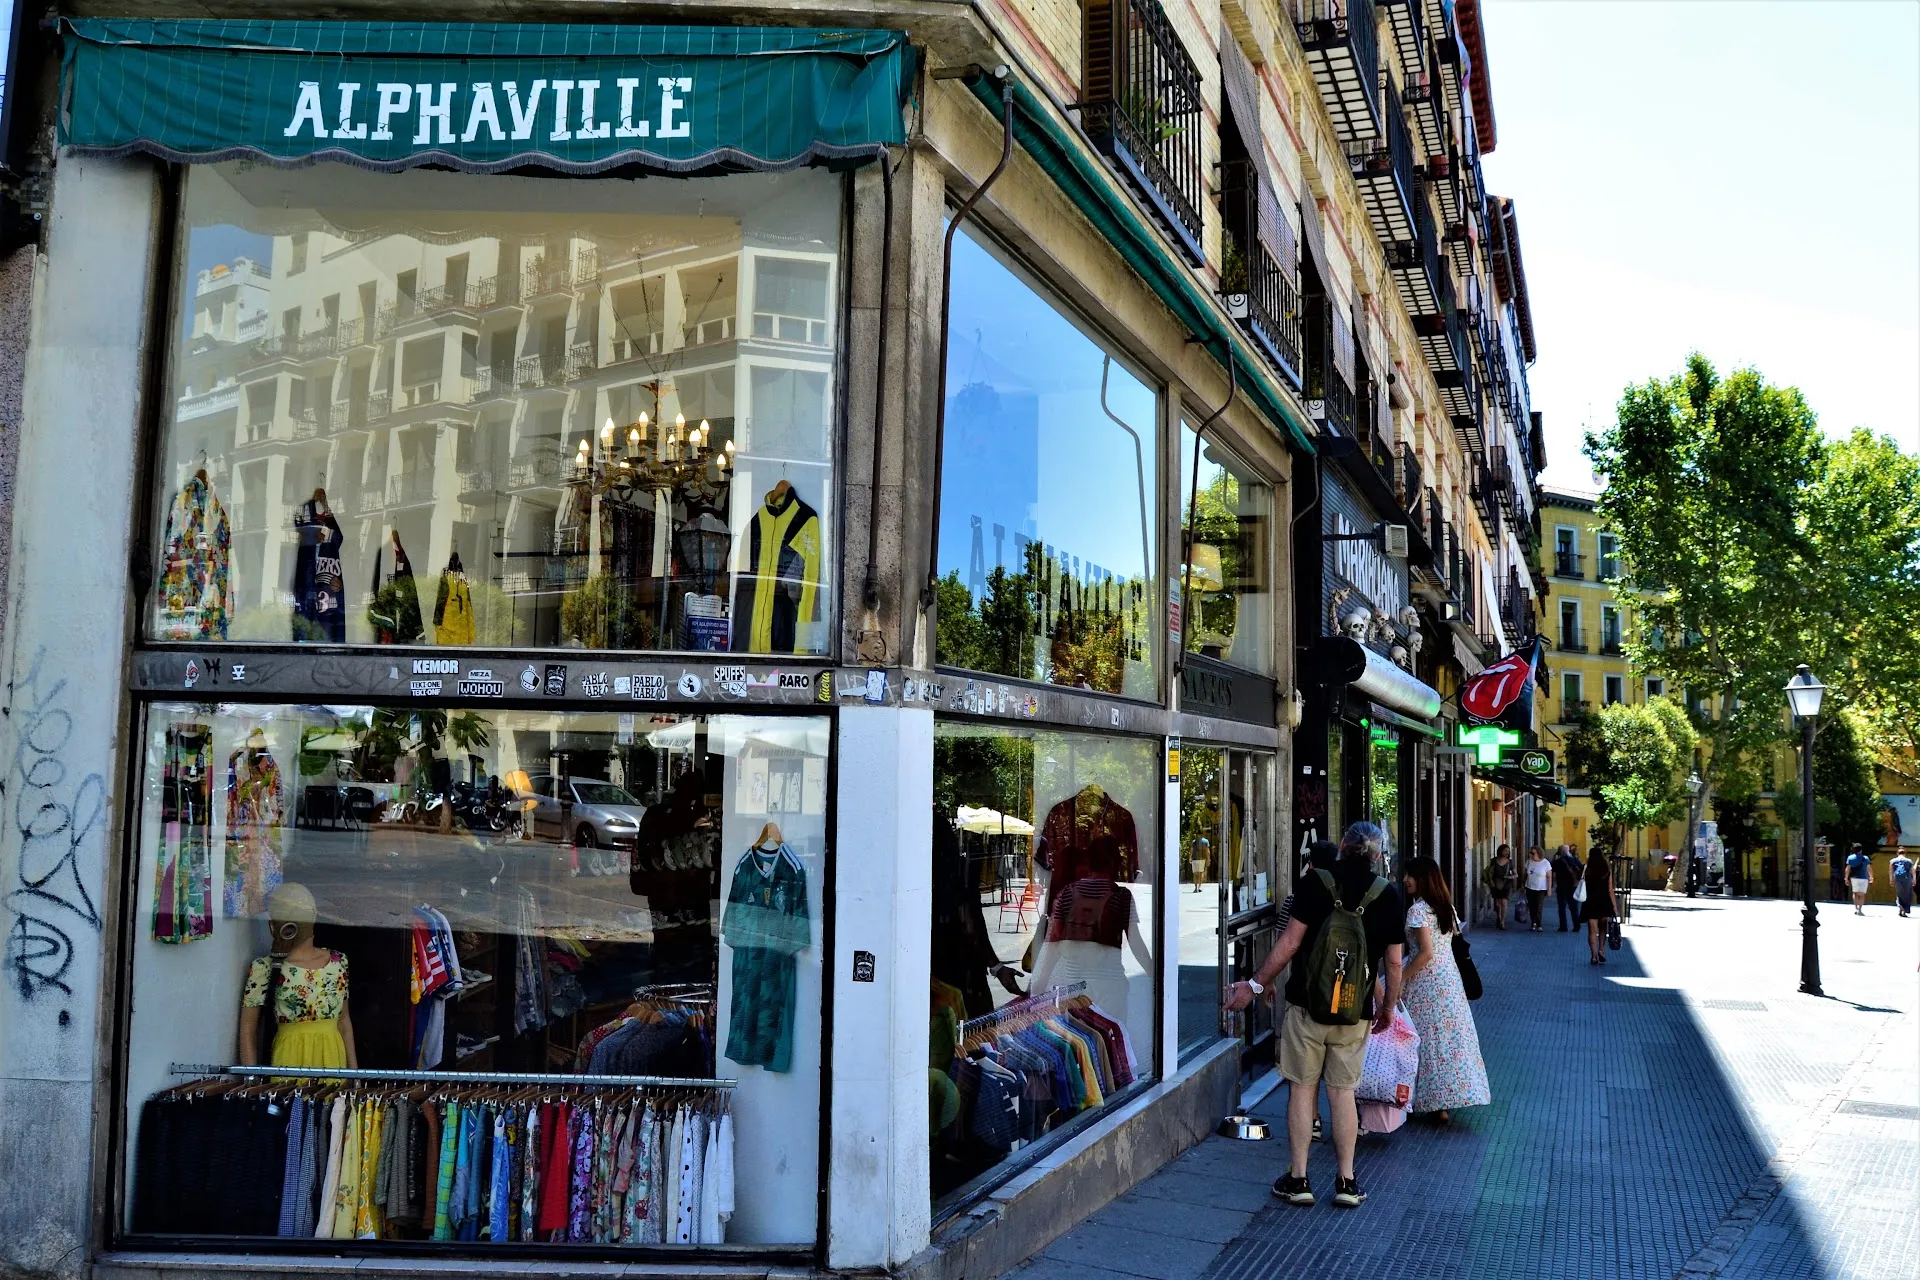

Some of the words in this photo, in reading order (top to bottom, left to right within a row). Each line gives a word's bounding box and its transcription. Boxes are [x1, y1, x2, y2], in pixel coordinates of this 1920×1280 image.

[284, 77, 692, 144] ALPHAVILLE
[412, 659, 459, 674] KEMOR
[714, 666, 745, 681] SPUFFS
[779, 674, 809, 688] RARO
[460, 683, 501, 695] WOHOU
[1527, 757, 1544, 768] vap
